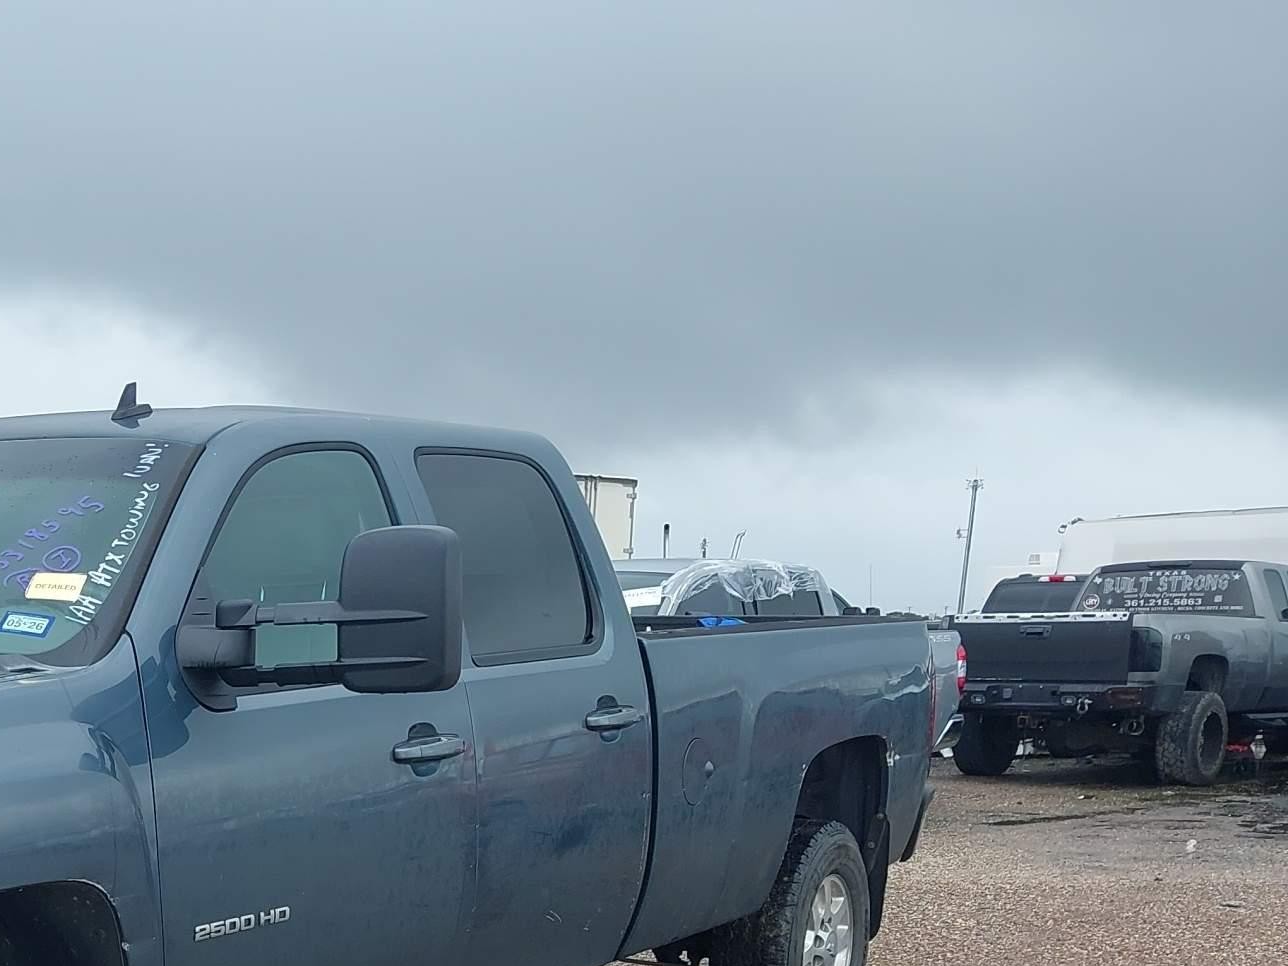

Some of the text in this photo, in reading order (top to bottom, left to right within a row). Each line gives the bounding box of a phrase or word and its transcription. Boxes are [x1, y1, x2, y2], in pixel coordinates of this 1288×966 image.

[88, 552, 126, 587] ATX
[1103, 573, 1230, 594] BUILT STRONG
[34, 583, 77, 591] DETAILED
[194, 906, 291, 942] 2500 HD
